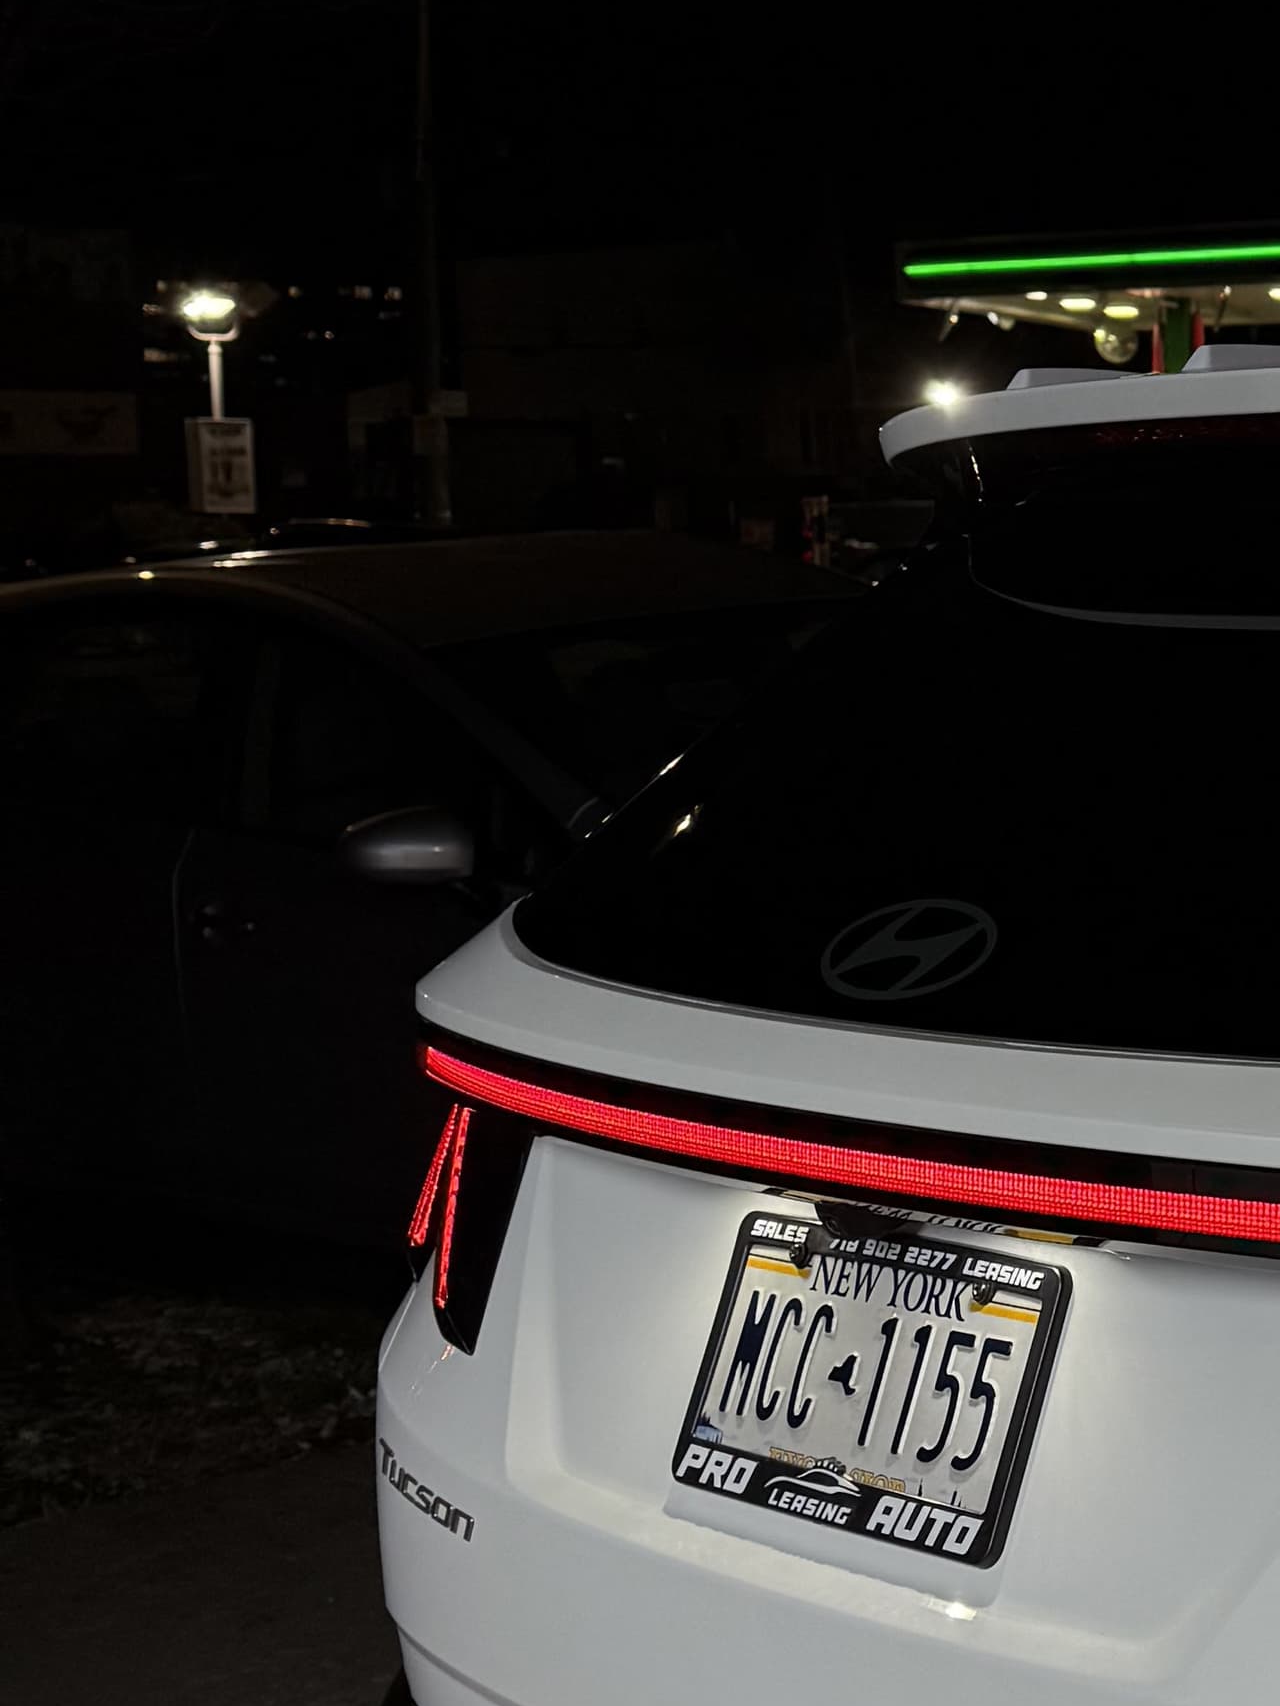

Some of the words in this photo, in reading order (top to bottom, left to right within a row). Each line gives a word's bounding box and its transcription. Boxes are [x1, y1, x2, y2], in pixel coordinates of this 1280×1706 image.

[750, 1219, 809, 1243] SALES
[863, 1239, 901, 1260] 902
[906, 1246, 957, 1271] 2277
[962, 1257, 1045, 1290] LEASING
[810, 1253, 882, 1303] NEW
[886, 1269, 967, 1321] YORK
[719, 1290, 837, 1429] MCC
[857, 1317, 1013, 1471] 1155
[676, 1447, 758, 1495] PRO
[866, 1497, 984, 1556] AUTO
[767, 1485, 853, 1526] LEASING
